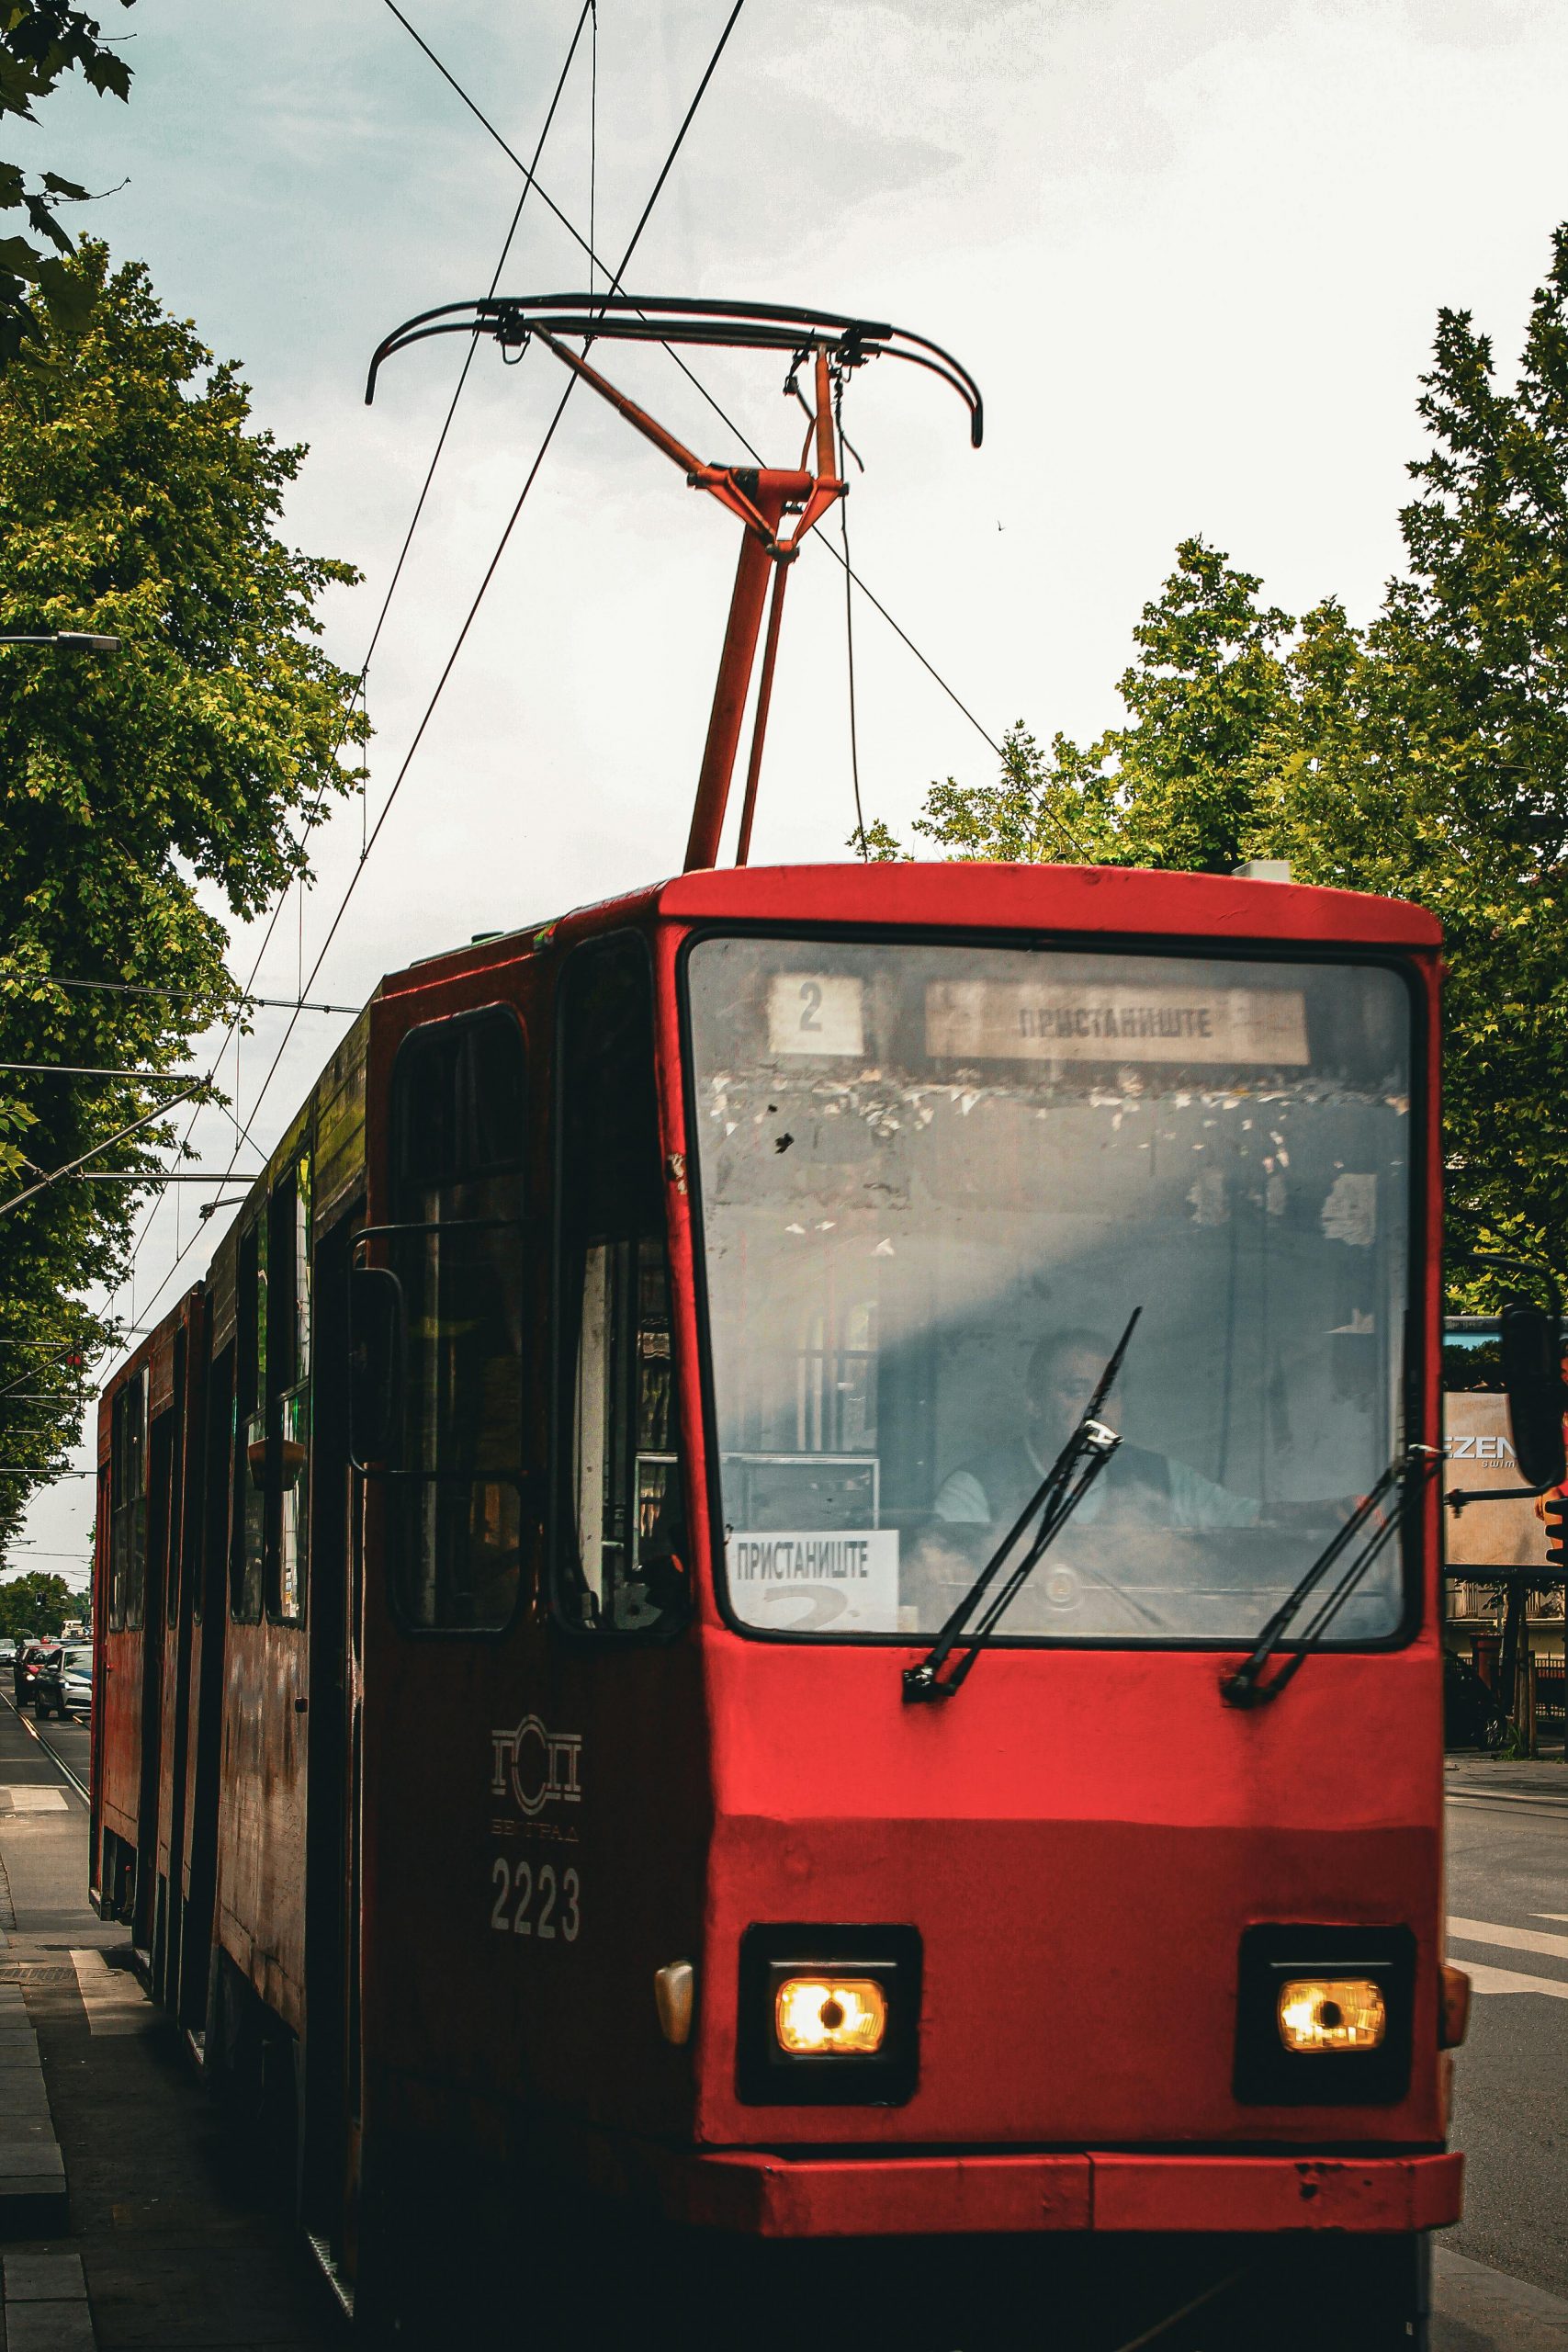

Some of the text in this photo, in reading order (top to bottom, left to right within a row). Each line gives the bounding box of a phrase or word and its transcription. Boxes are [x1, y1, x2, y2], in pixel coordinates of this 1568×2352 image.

[799, 980, 823, 1032] 2
[1017, 1006, 1213, 1039] ПРИСТАНИШТЕ
[737, 1540, 869, 1580] ПРИСТАНИШТЕ
[491, 1858, 580, 1942] 2223
